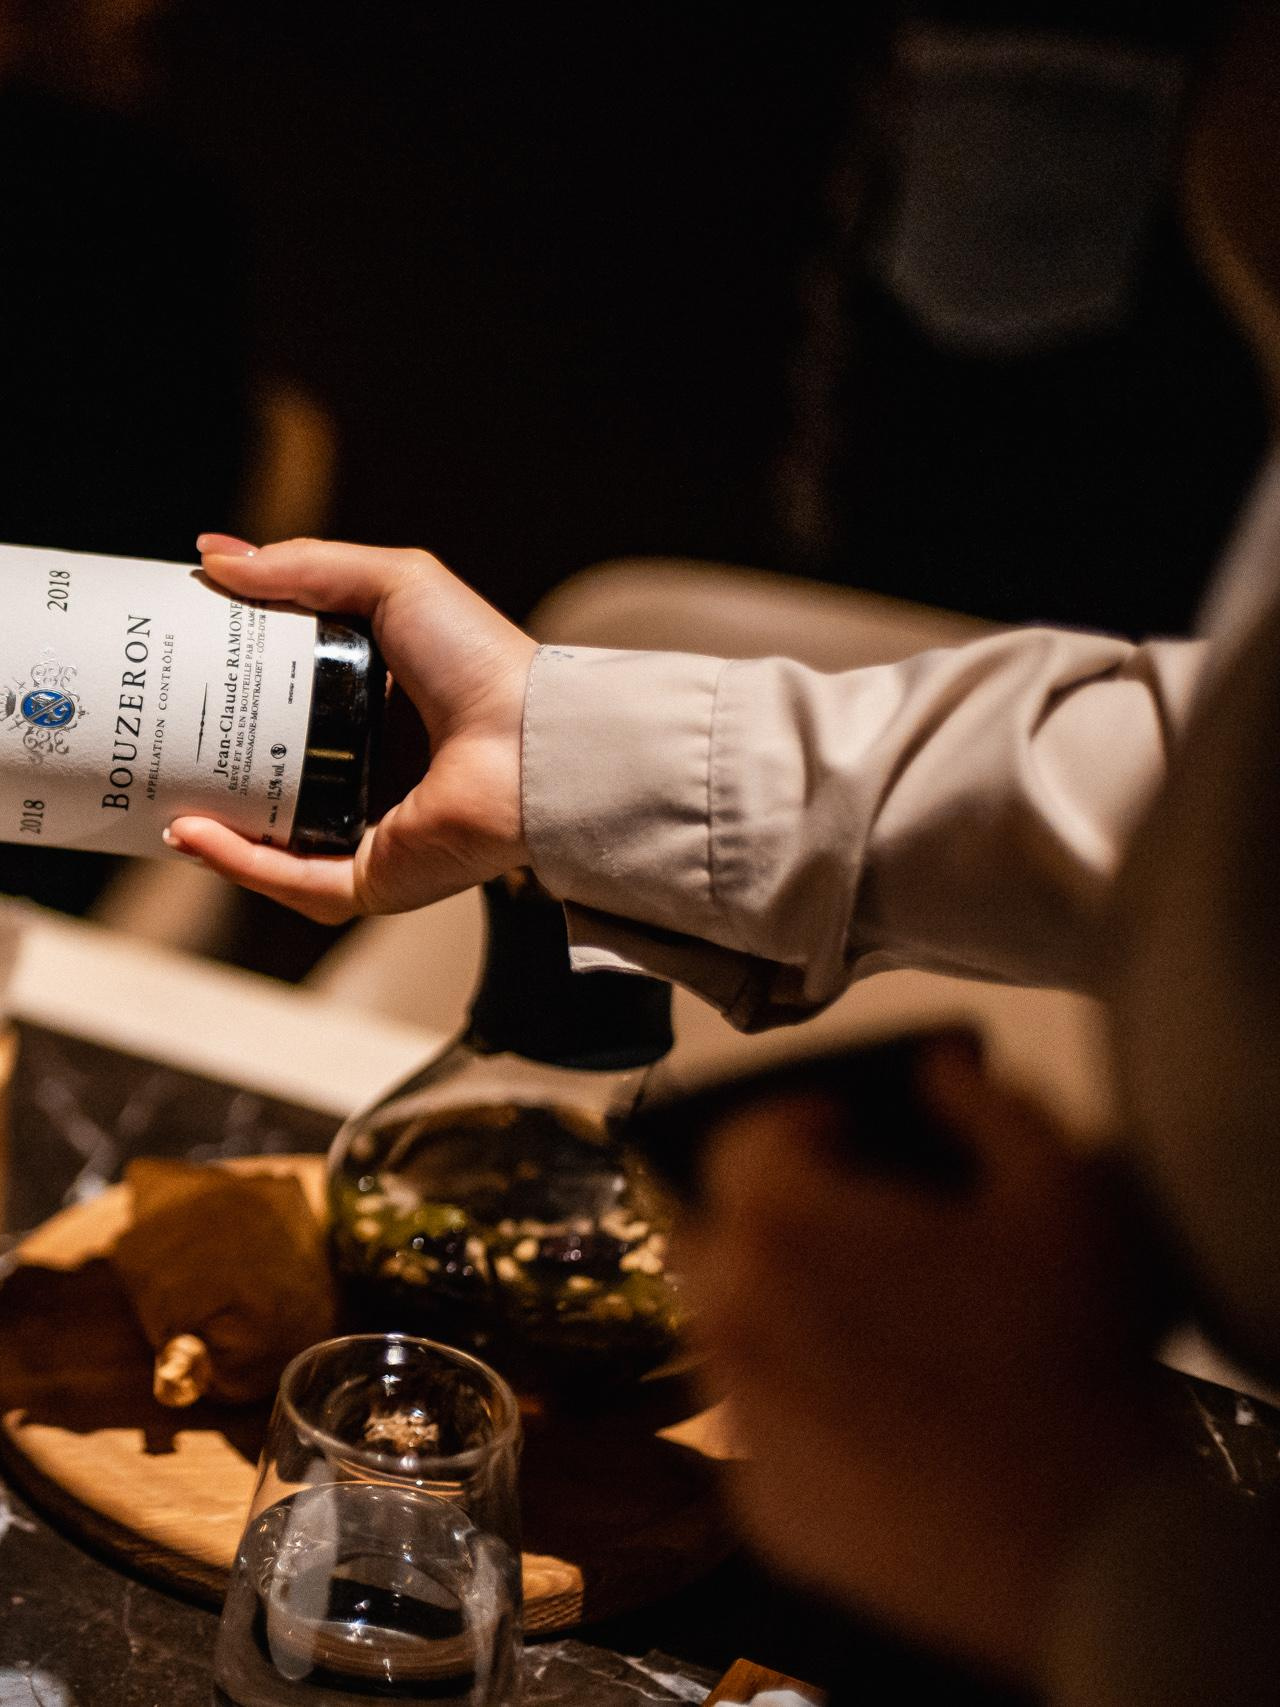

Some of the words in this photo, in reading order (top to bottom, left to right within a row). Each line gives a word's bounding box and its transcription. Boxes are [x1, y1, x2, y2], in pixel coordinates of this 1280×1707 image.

[47, 570, 70, 612] 2018
[213, 672, 238, 777] Jean-Claude
[226, 601, 243, 669] RAMONE
[241, 663, 252, 713] BOUTEILLE
[101, 614, 152, 811] BOUZERON
[146, 719, 165, 800] APPELLATION
[159, 634, 174, 710] CONTRÔLÉE
[238, 716, 246, 728] EN
[242, 661, 263, 773] CHASSAGNE-MONTRACHET
[234, 750, 242, 762] ET
[236, 731, 245, 748] MIS
[272, 763, 285, 780] vol.
[20, 799, 45, 834] 2018
